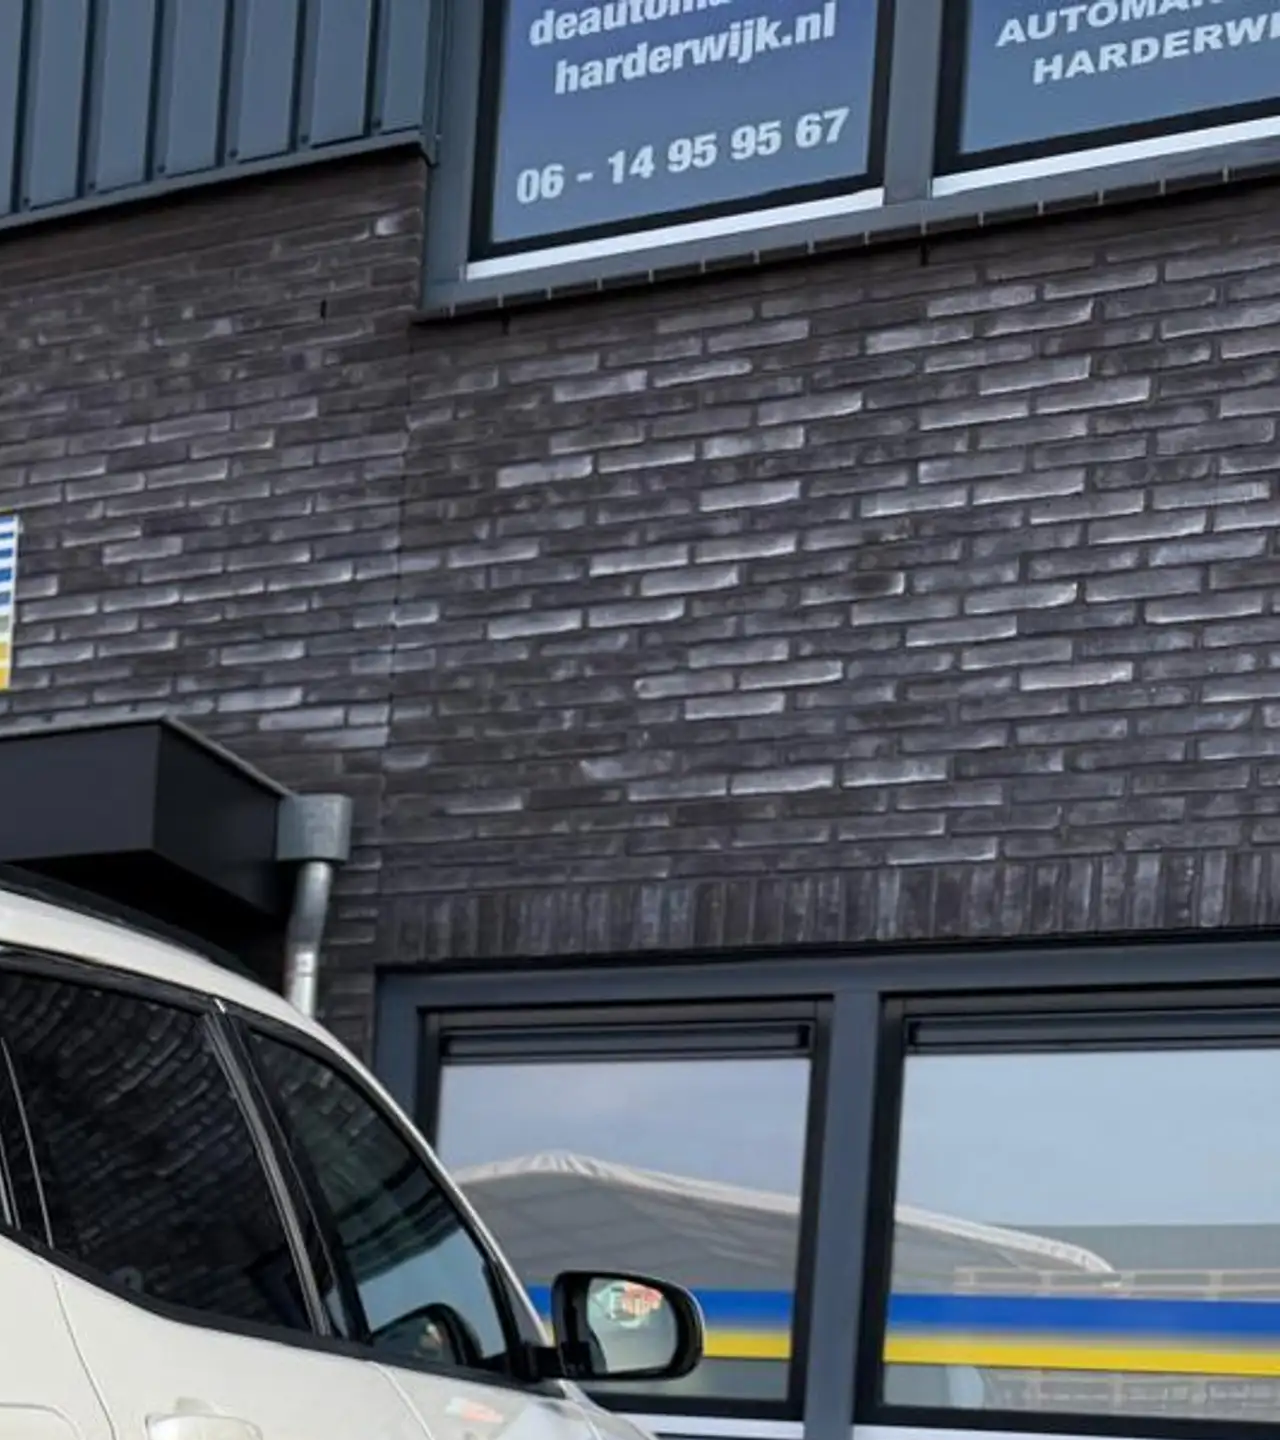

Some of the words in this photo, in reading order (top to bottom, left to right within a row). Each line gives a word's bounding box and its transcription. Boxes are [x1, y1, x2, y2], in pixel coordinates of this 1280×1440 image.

[554, 1, 838, 94] harderwijk.nl
[995, 0, 1222, 47] AUTOMA
[516, 164, 565, 203] 06
[608, 146, 655, 184] 14
[667, 132, 717, 174] 95
[730, 121, 782, 160] 95
[795, 107, 850, 149] 67
